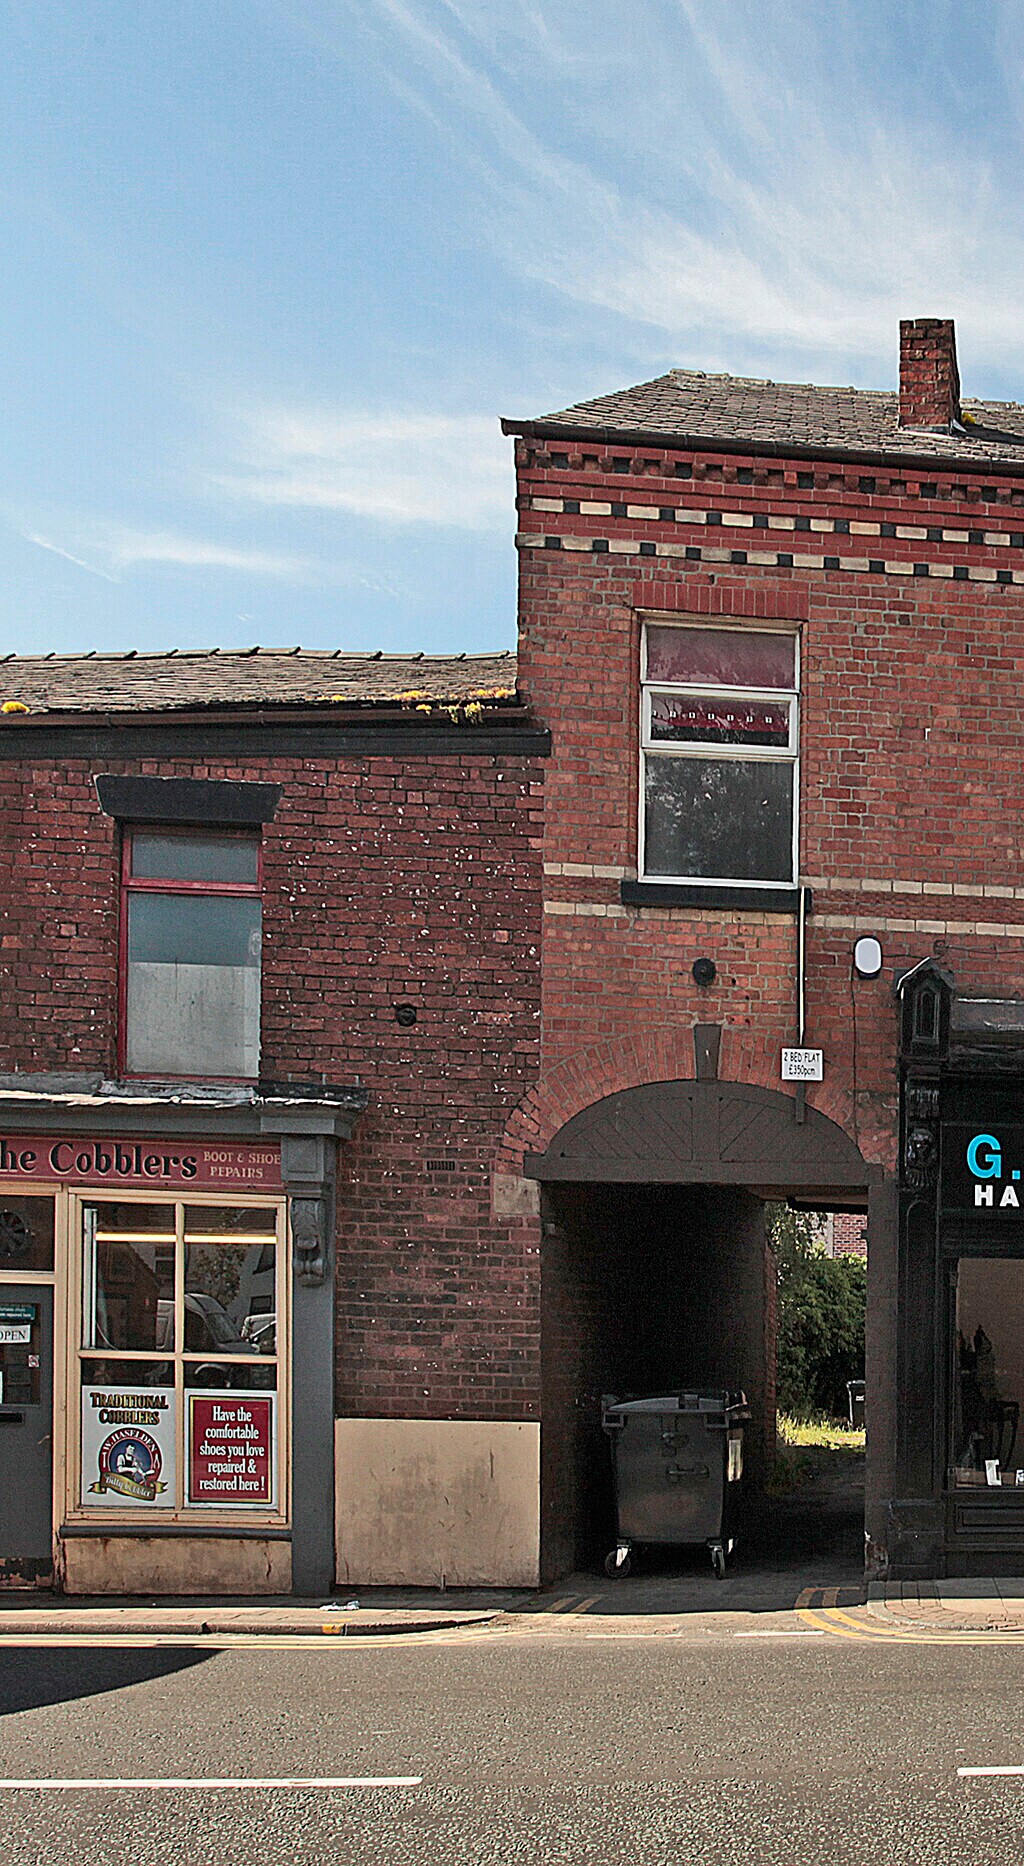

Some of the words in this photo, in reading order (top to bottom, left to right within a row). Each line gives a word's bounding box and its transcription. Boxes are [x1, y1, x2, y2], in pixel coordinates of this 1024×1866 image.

[784, 1052, 788, 1061] 2
[790, 1052, 802, 1062] BED
[804, 1052, 820, 1062] FLAT
[0, 1141, 37, 1173] he
[49, 1142, 198, 1180] Cobblers
[204, 1152, 233, 1162] BOOT
[237, 1153, 244, 1163] &
[248, 1153, 281, 1164] SHOE
[90, 1392, 169, 1409] TRADITIONAL
[99, 1409, 160, 1425] COBBLERS
[212, 1406, 235, 1421] Have
[237, 1407, 252, 1422] the
[205, 1423, 260, 1439] comfortable
[199, 1440, 226, 1456] shoes
[227, 1446, 245, 1458] you
[246, 1441, 265, 1457] love
[207, 1458, 246, 1475] repaired
[247, 1458, 257, 1473] &
[199, 1475, 237, 1490] restored
[238, 1475, 260, 1491] here
